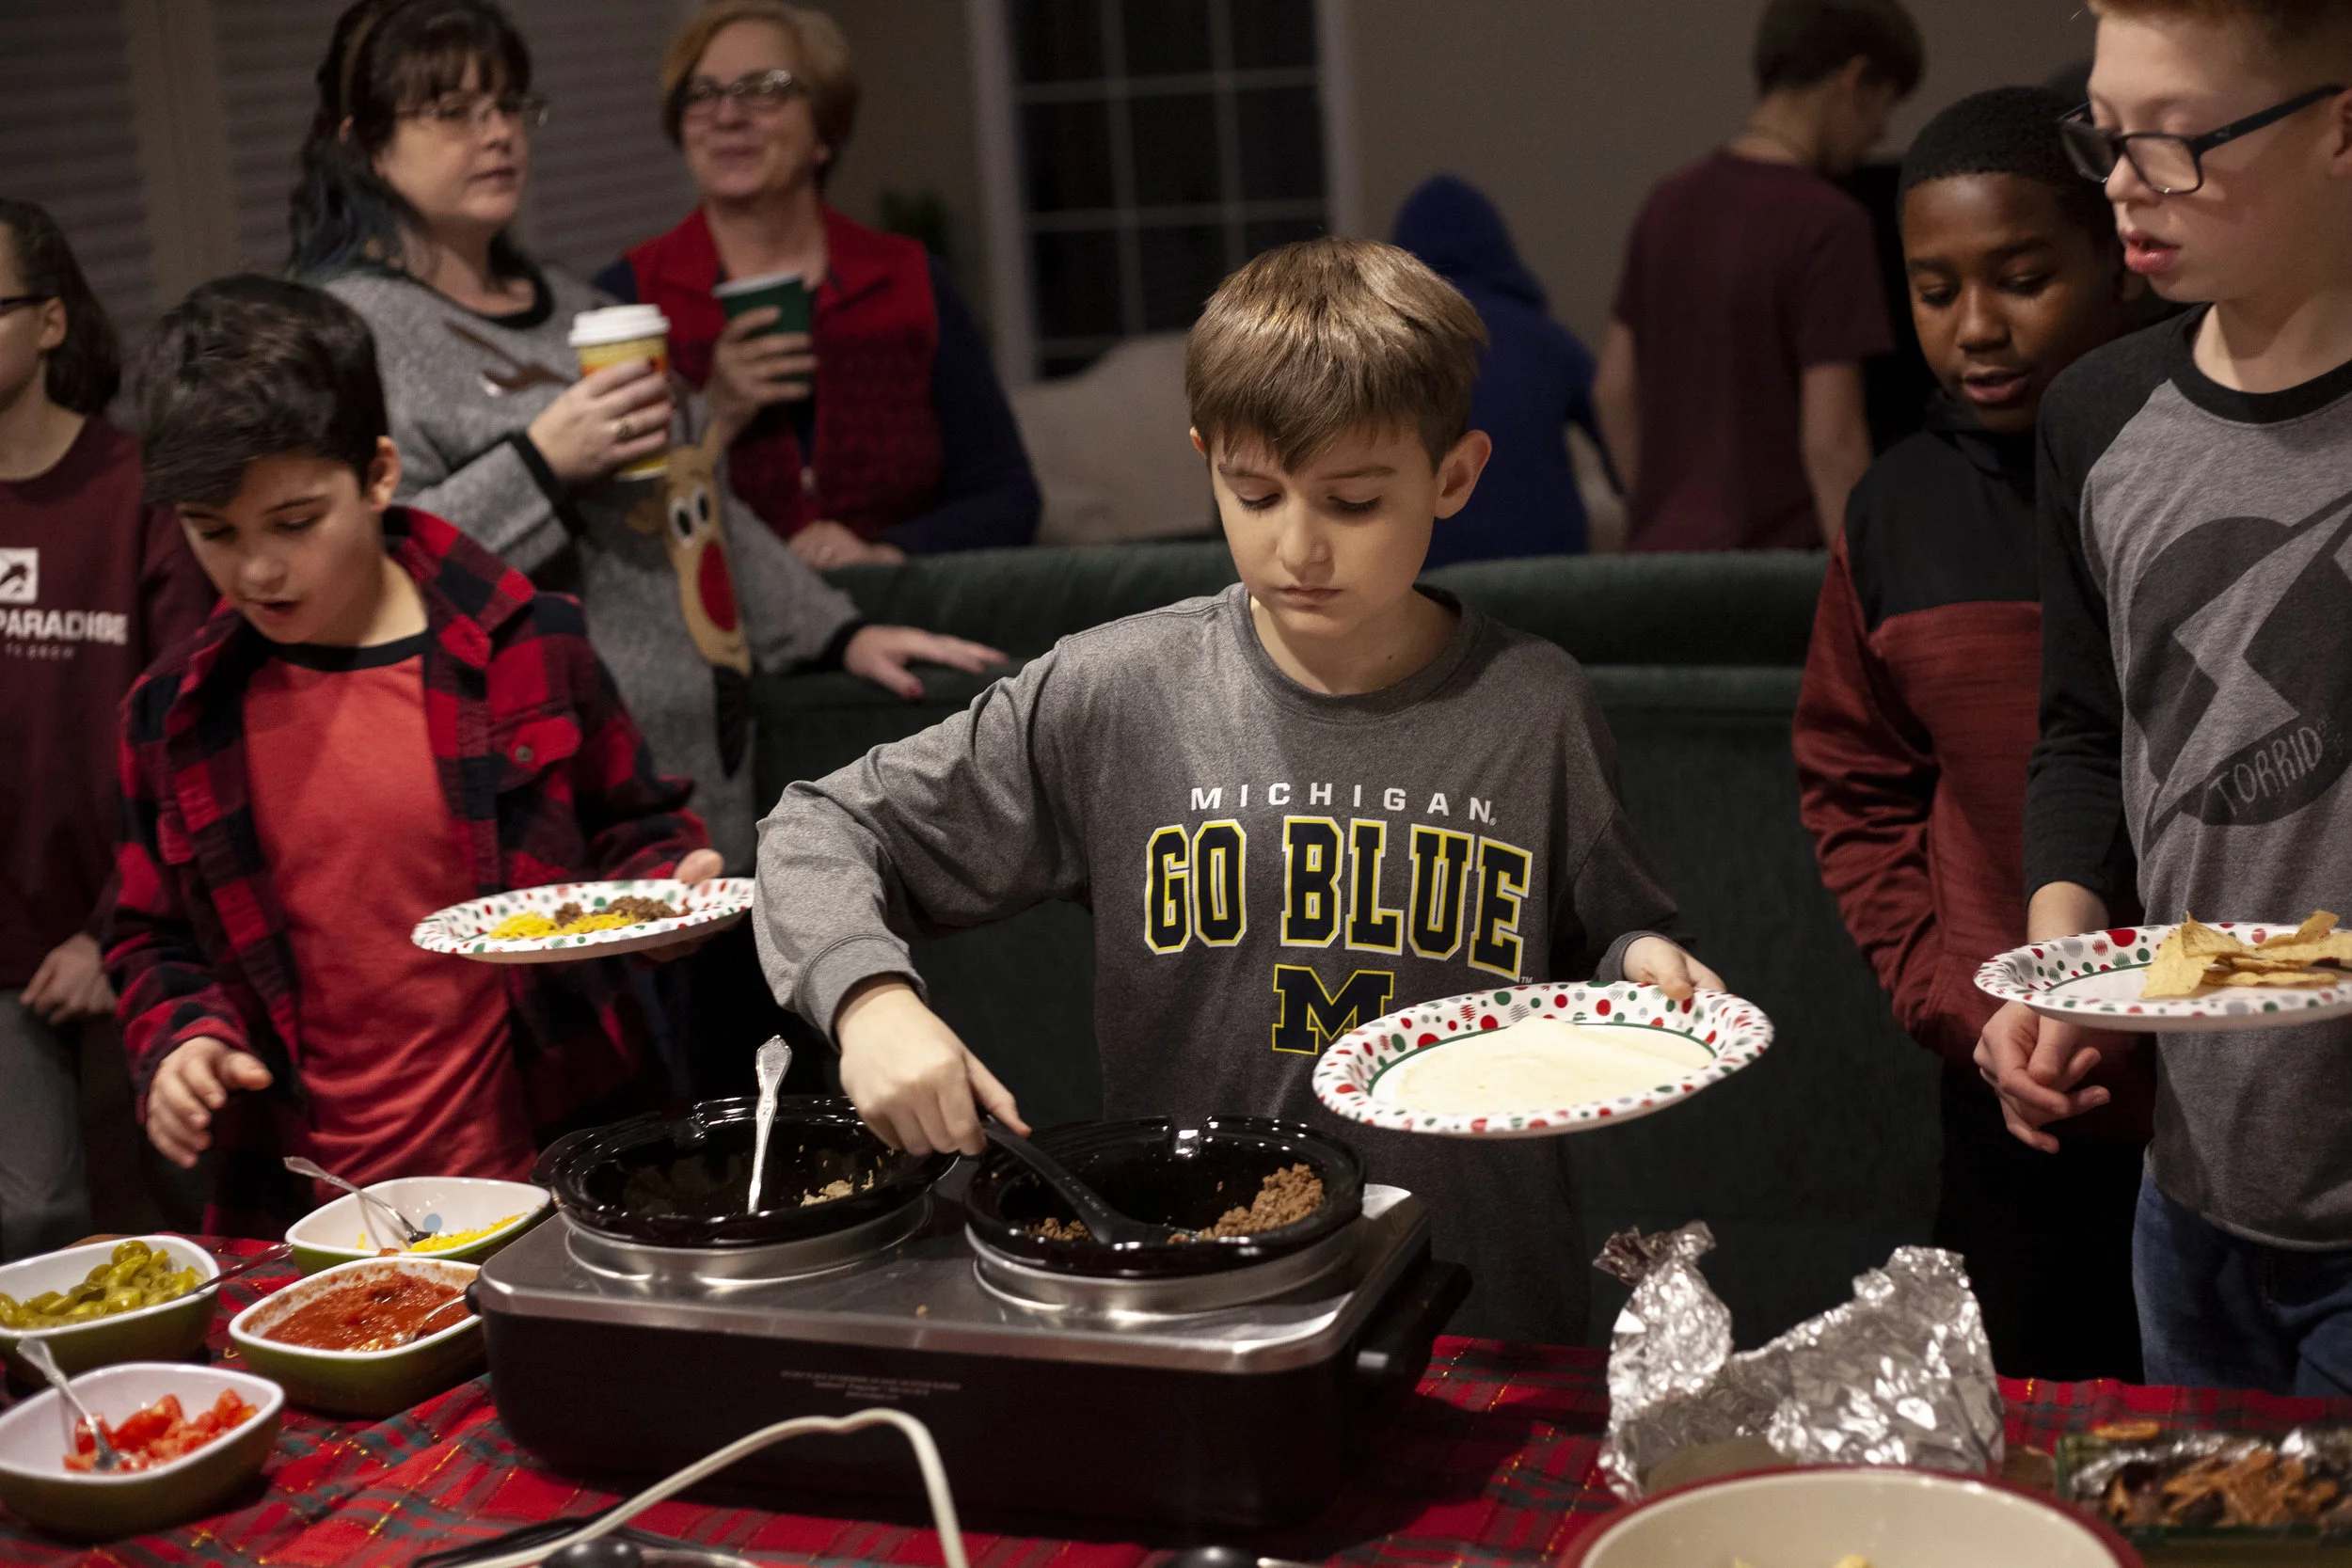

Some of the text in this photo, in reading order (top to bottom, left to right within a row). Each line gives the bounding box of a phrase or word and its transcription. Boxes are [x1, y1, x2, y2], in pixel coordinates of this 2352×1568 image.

[1191, 782, 1491, 823] MICHIGAN
[2208, 726, 2324, 816] TORRID
[1144, 816, 1533, 982] GO BLUE
[1272, 963, 1394, 1054] M
